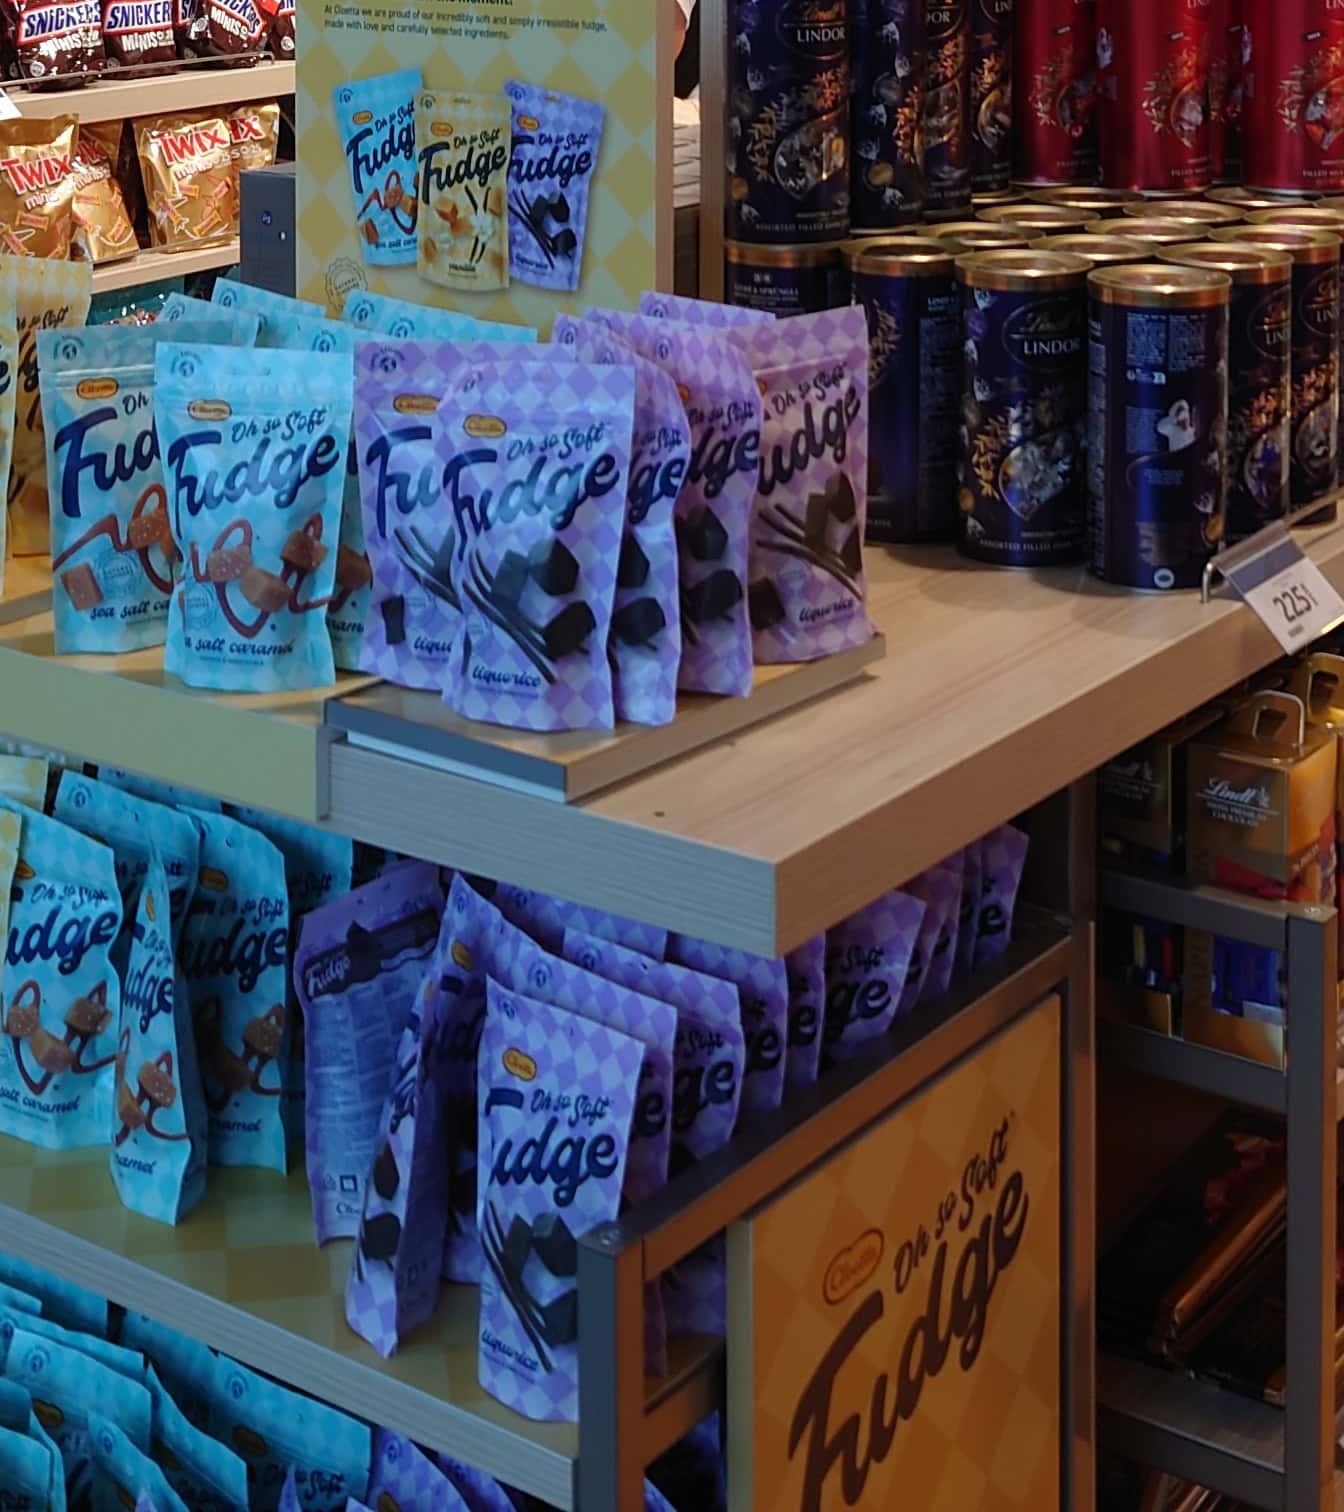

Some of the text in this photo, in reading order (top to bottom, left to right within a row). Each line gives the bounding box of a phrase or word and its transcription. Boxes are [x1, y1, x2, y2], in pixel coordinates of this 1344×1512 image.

[210, 6, 242, 36] MINIS
[325, 19, 344, 28] made
[347, 20, 361, 30] with
[364, 21, 379, 31] love
[382, 22, 394, 32] and
[397, 23, 428, 36] carefully
[431, 25, 462, 36] selected
[362, 8, 372, 16] we
[374, 9, 386, 17] are
[388, 8, 410, 21] proud
[413, 9, 419, 18] of
[421, 11, 434, 19] our
[436, 11, 474, 24] incredibly
[476, 14, 489, 24] soft
[492, 15, 506, 25] and
[510, 17, 535, 29] simply
[797, 26, 846, 42] LINDOR
[122, 32, 157, 52] MINIS
[153, 126, 230, 166] TWIX
[1, 153, 70, 195] TWIX
[418, 139, 506, 205] Fudge
[123, 391, 149, 414] Oh
[232, 407, 328, 443] Oh so Soft
[507, 422, 606, 462] Oh so Soft
[168, 430, 340, 541] Fudge
[442, 448, 621, 563] Fudge
[90, 600, 147, 620] sea salt
[1273, 584, 1311, 624] 225
[195, 637, 226, 651] salt
[472, 664, 542, 687] liquorice
[1208, 777, 1256, 803] Lindt
[306, 956, 352, 993] Fudge
[893, 1117, 1009, 1295] Oh so Soft
[788, 1170, 1029, 1512] Fudge
